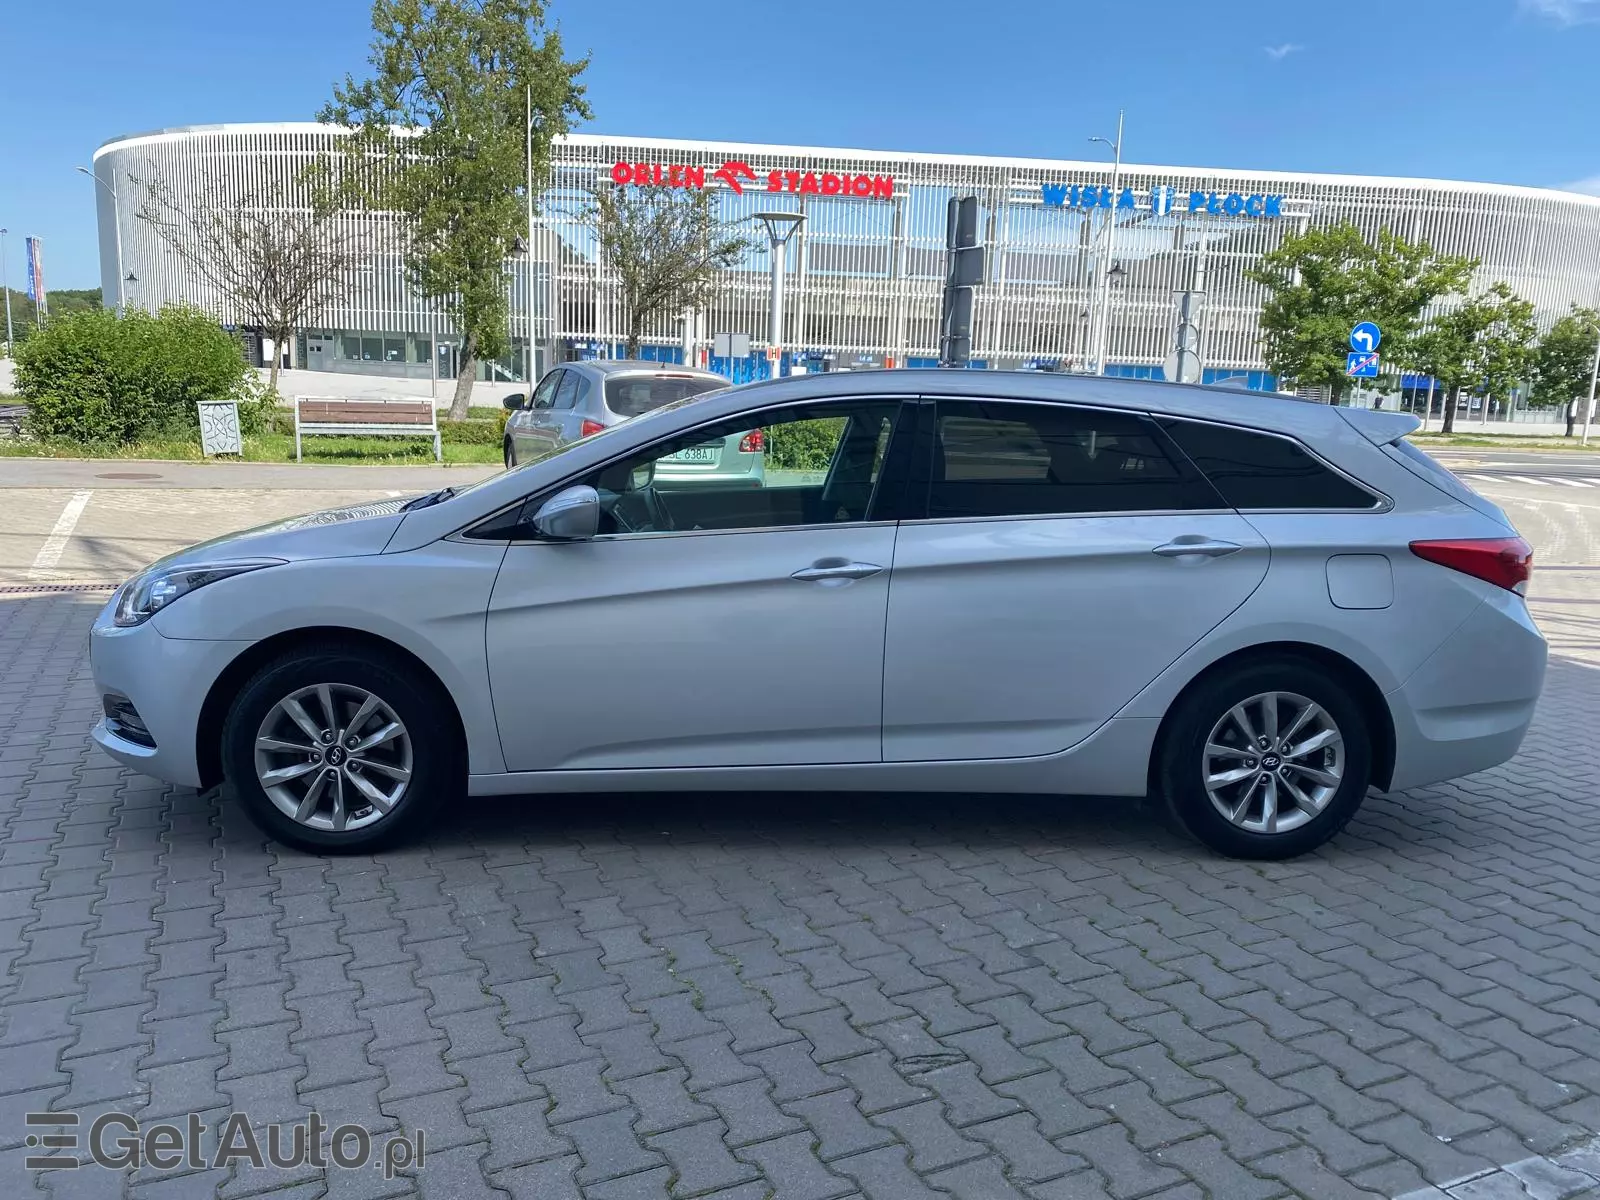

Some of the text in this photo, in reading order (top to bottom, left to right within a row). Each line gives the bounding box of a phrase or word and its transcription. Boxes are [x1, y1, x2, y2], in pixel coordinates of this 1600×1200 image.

[611, 161, 893, 199] ORLEN STADION
[1041, 183, 1283, 217] WISŁA PŁOCK
